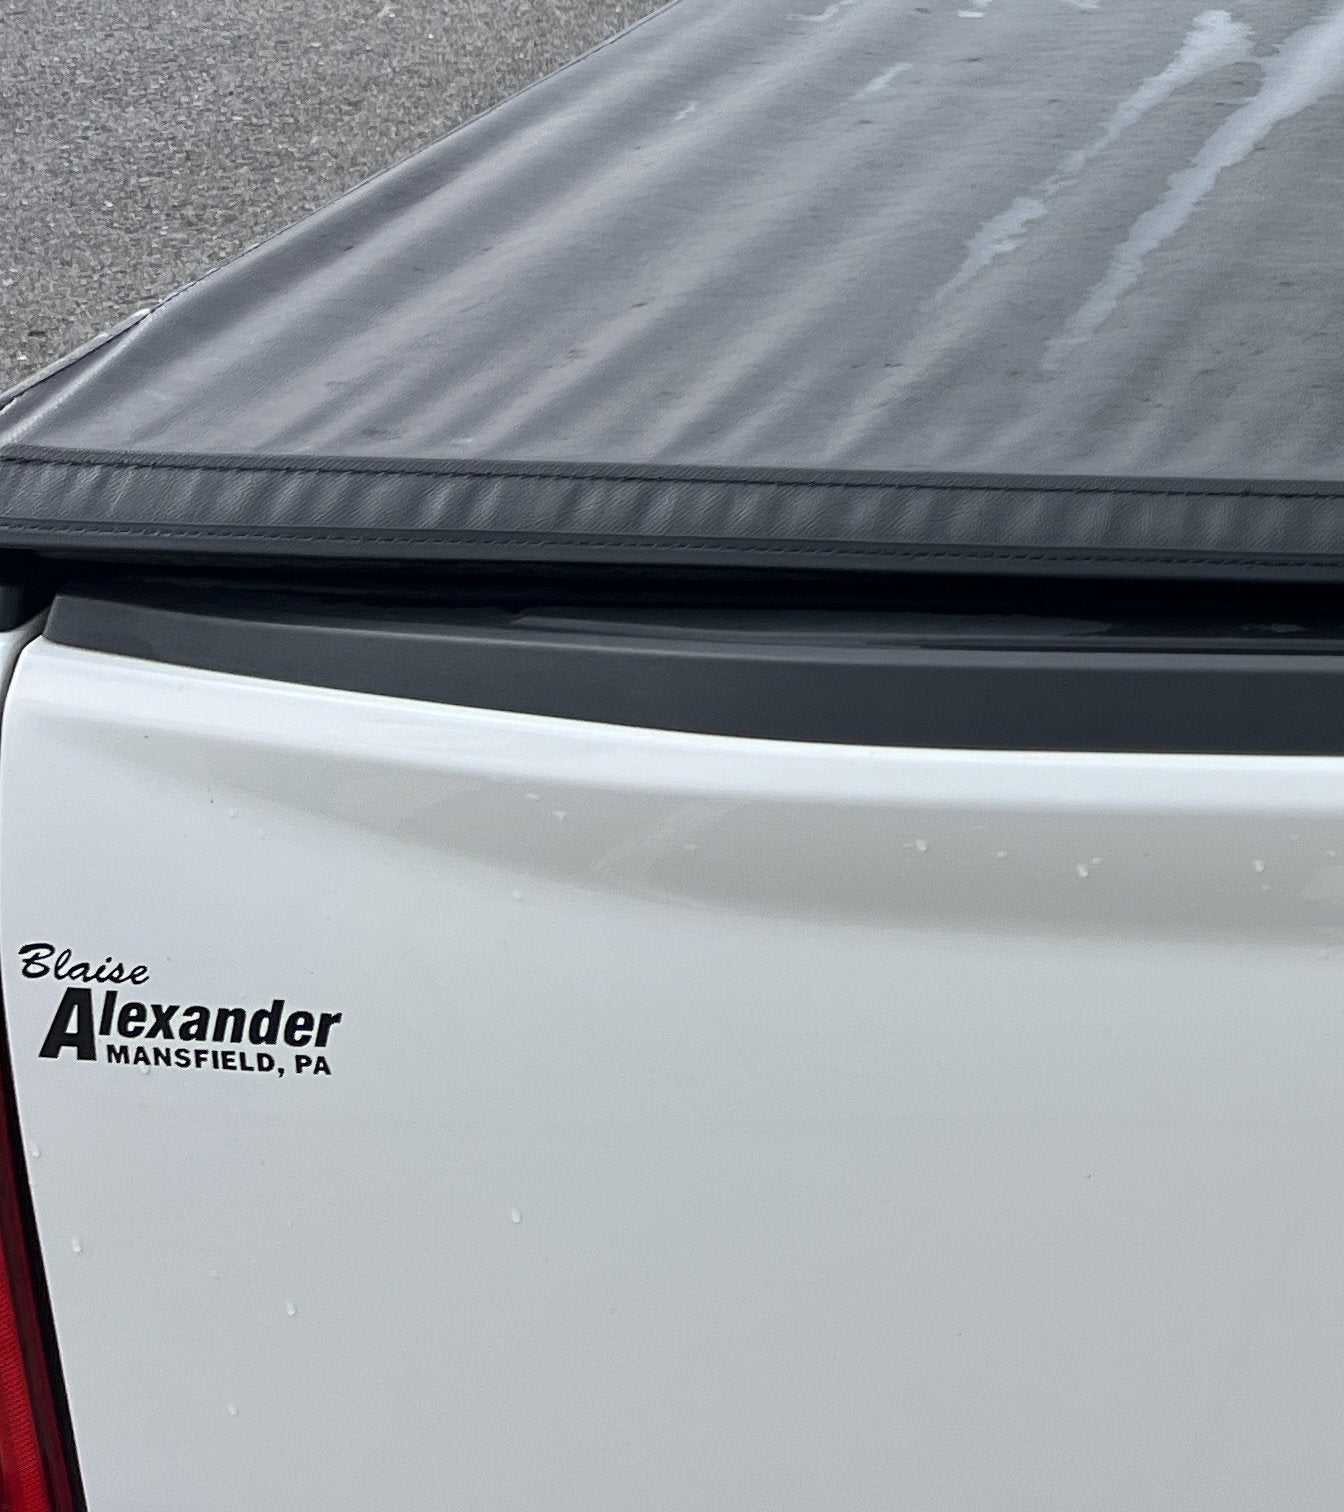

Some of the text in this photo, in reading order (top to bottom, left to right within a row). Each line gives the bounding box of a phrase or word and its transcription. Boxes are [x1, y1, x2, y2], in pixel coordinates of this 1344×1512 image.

[18, 942, 150, 985] Blaise
[38, 987, 342, 1061] Alexander
[106, 1044, 332, 1078] MANSFIELD, PA
